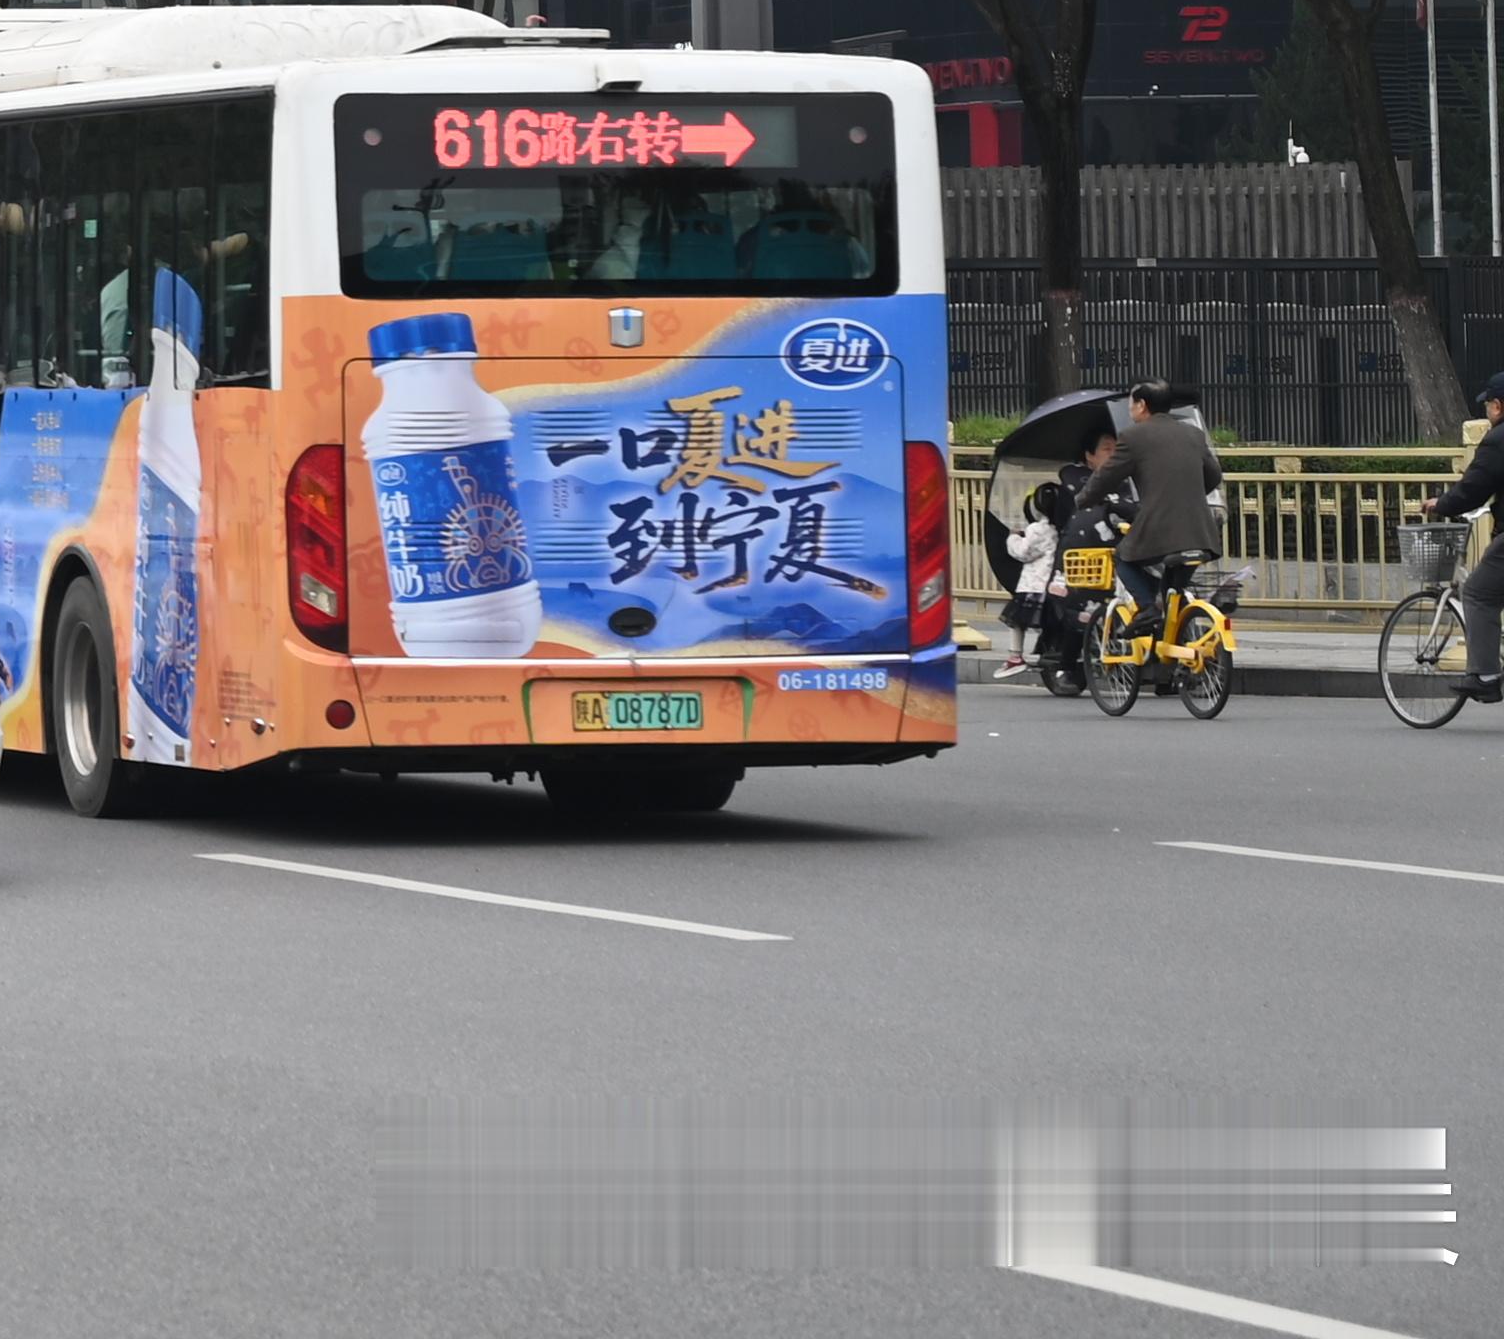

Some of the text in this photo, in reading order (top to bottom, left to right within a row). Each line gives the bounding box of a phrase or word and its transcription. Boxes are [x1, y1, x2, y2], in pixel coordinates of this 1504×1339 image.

[434, 108, 682, 168] 616路右转
[799, 337, 872, 374] 夏进
[545, 386, 842, 496] 一口夏进
[380, 490, 424, 599] 纯牛奶
[606, 480, 889, 601] 到宁夏
[777, 671, 887, 691] 06-181498
